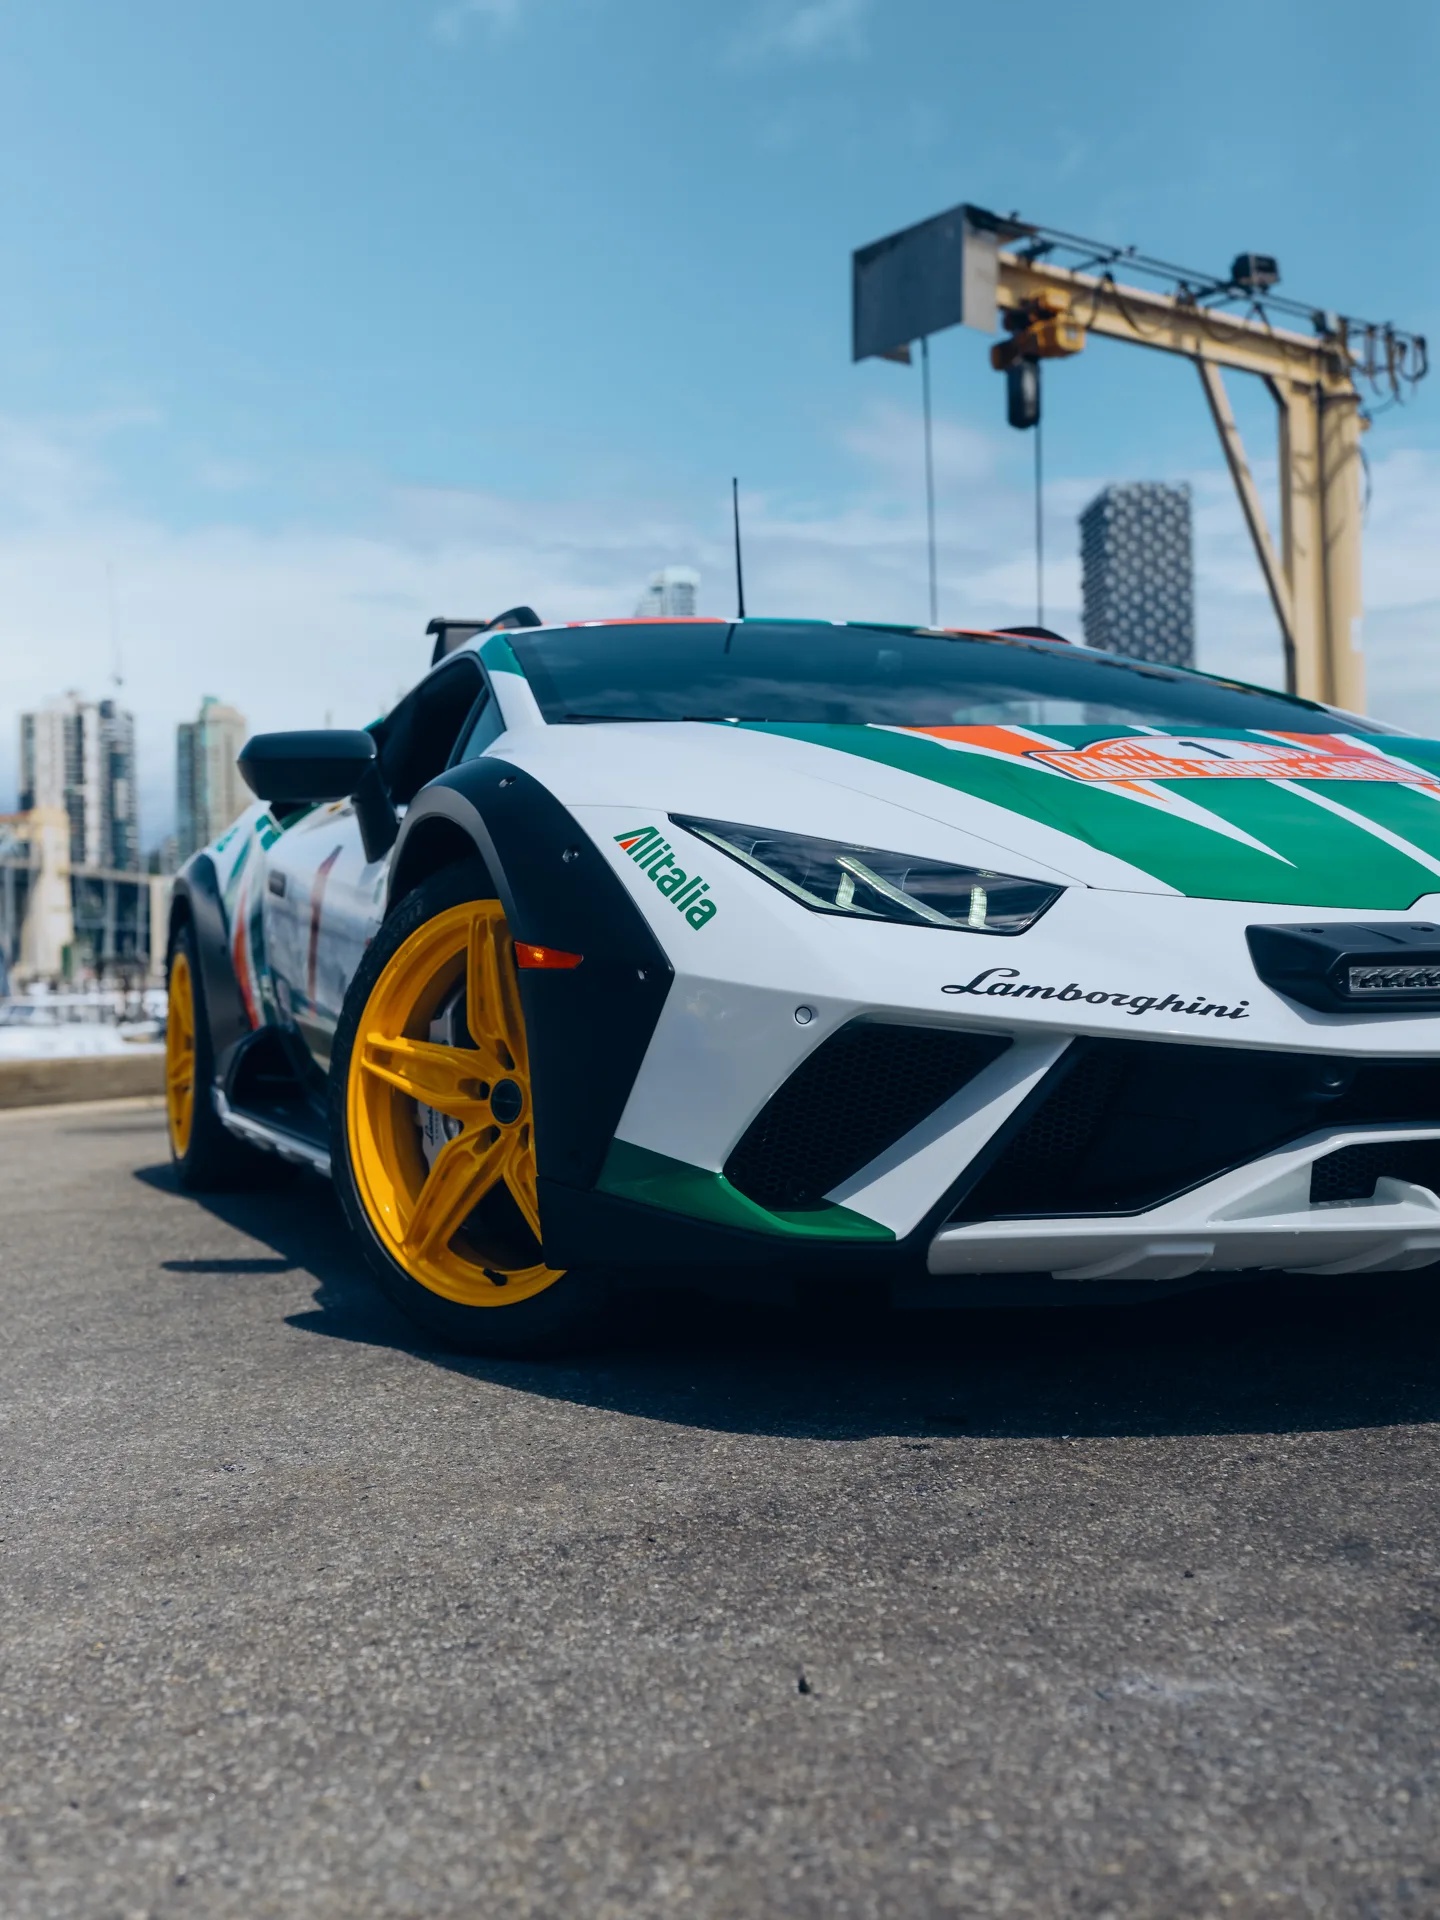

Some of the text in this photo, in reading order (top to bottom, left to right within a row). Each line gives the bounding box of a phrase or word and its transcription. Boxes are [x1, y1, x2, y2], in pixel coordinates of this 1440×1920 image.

[1050, 754, 1200, 777] RALLYE
[1178, 741, 1235, 759] 1
[613, 825, 717, 931] Alitalia
[940, 967, 1250, 1021] Lamborghini
